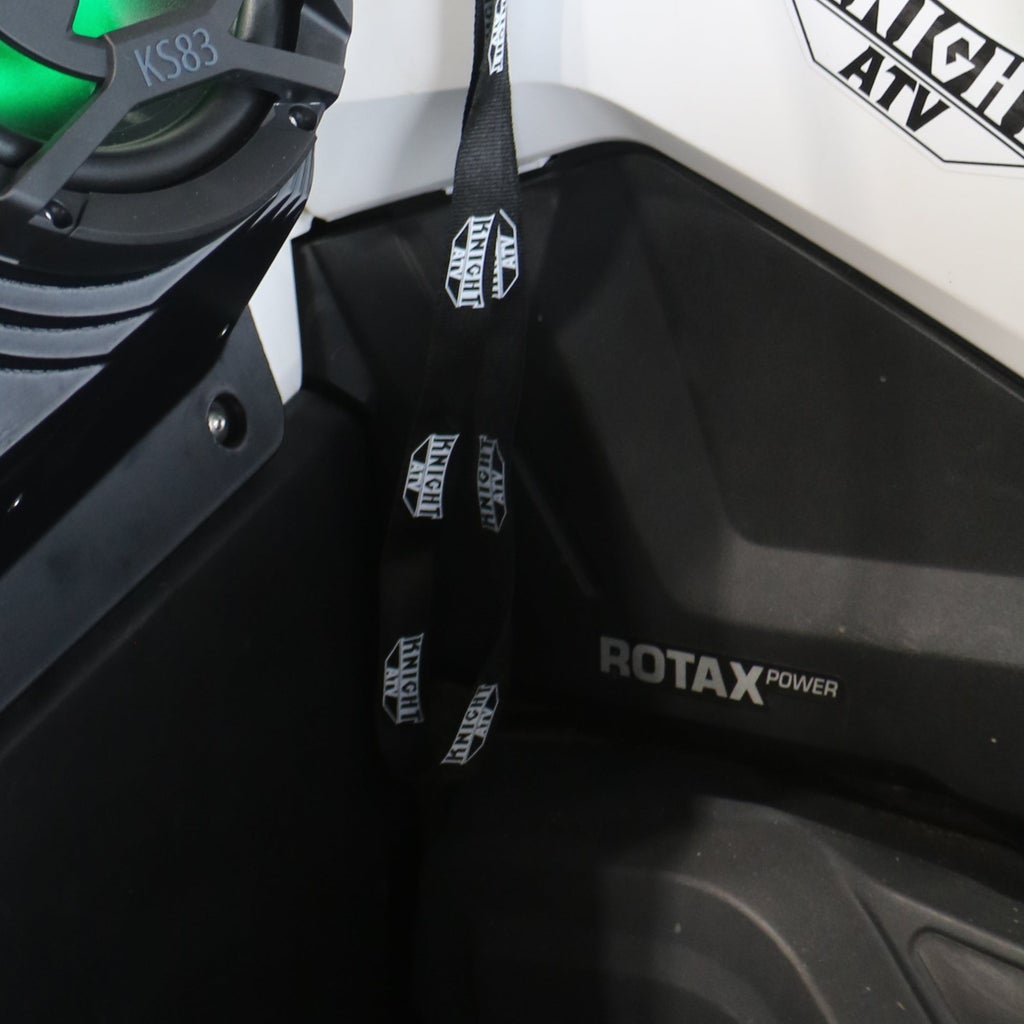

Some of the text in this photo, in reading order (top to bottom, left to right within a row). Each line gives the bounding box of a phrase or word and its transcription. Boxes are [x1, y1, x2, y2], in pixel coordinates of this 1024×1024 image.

[134, 28, 218, 87] KS83
[837, 45, 951, 132] ATV
[449, 246, 466, 280] ATV
[461, 219, 492, 305] KNIGHT
[498, 235, 516, 269] ATV
[407, 460, 425, 491] ATV
[419, 437, 455, 516] KNIGHT
[478, 439, 495, 528] KNIGHT
[400, 637, 422, 721] KNIGHT
[600, 635, 840, 706] ROTAX POWER
[444, 685, 492, 762] KNIGHT
